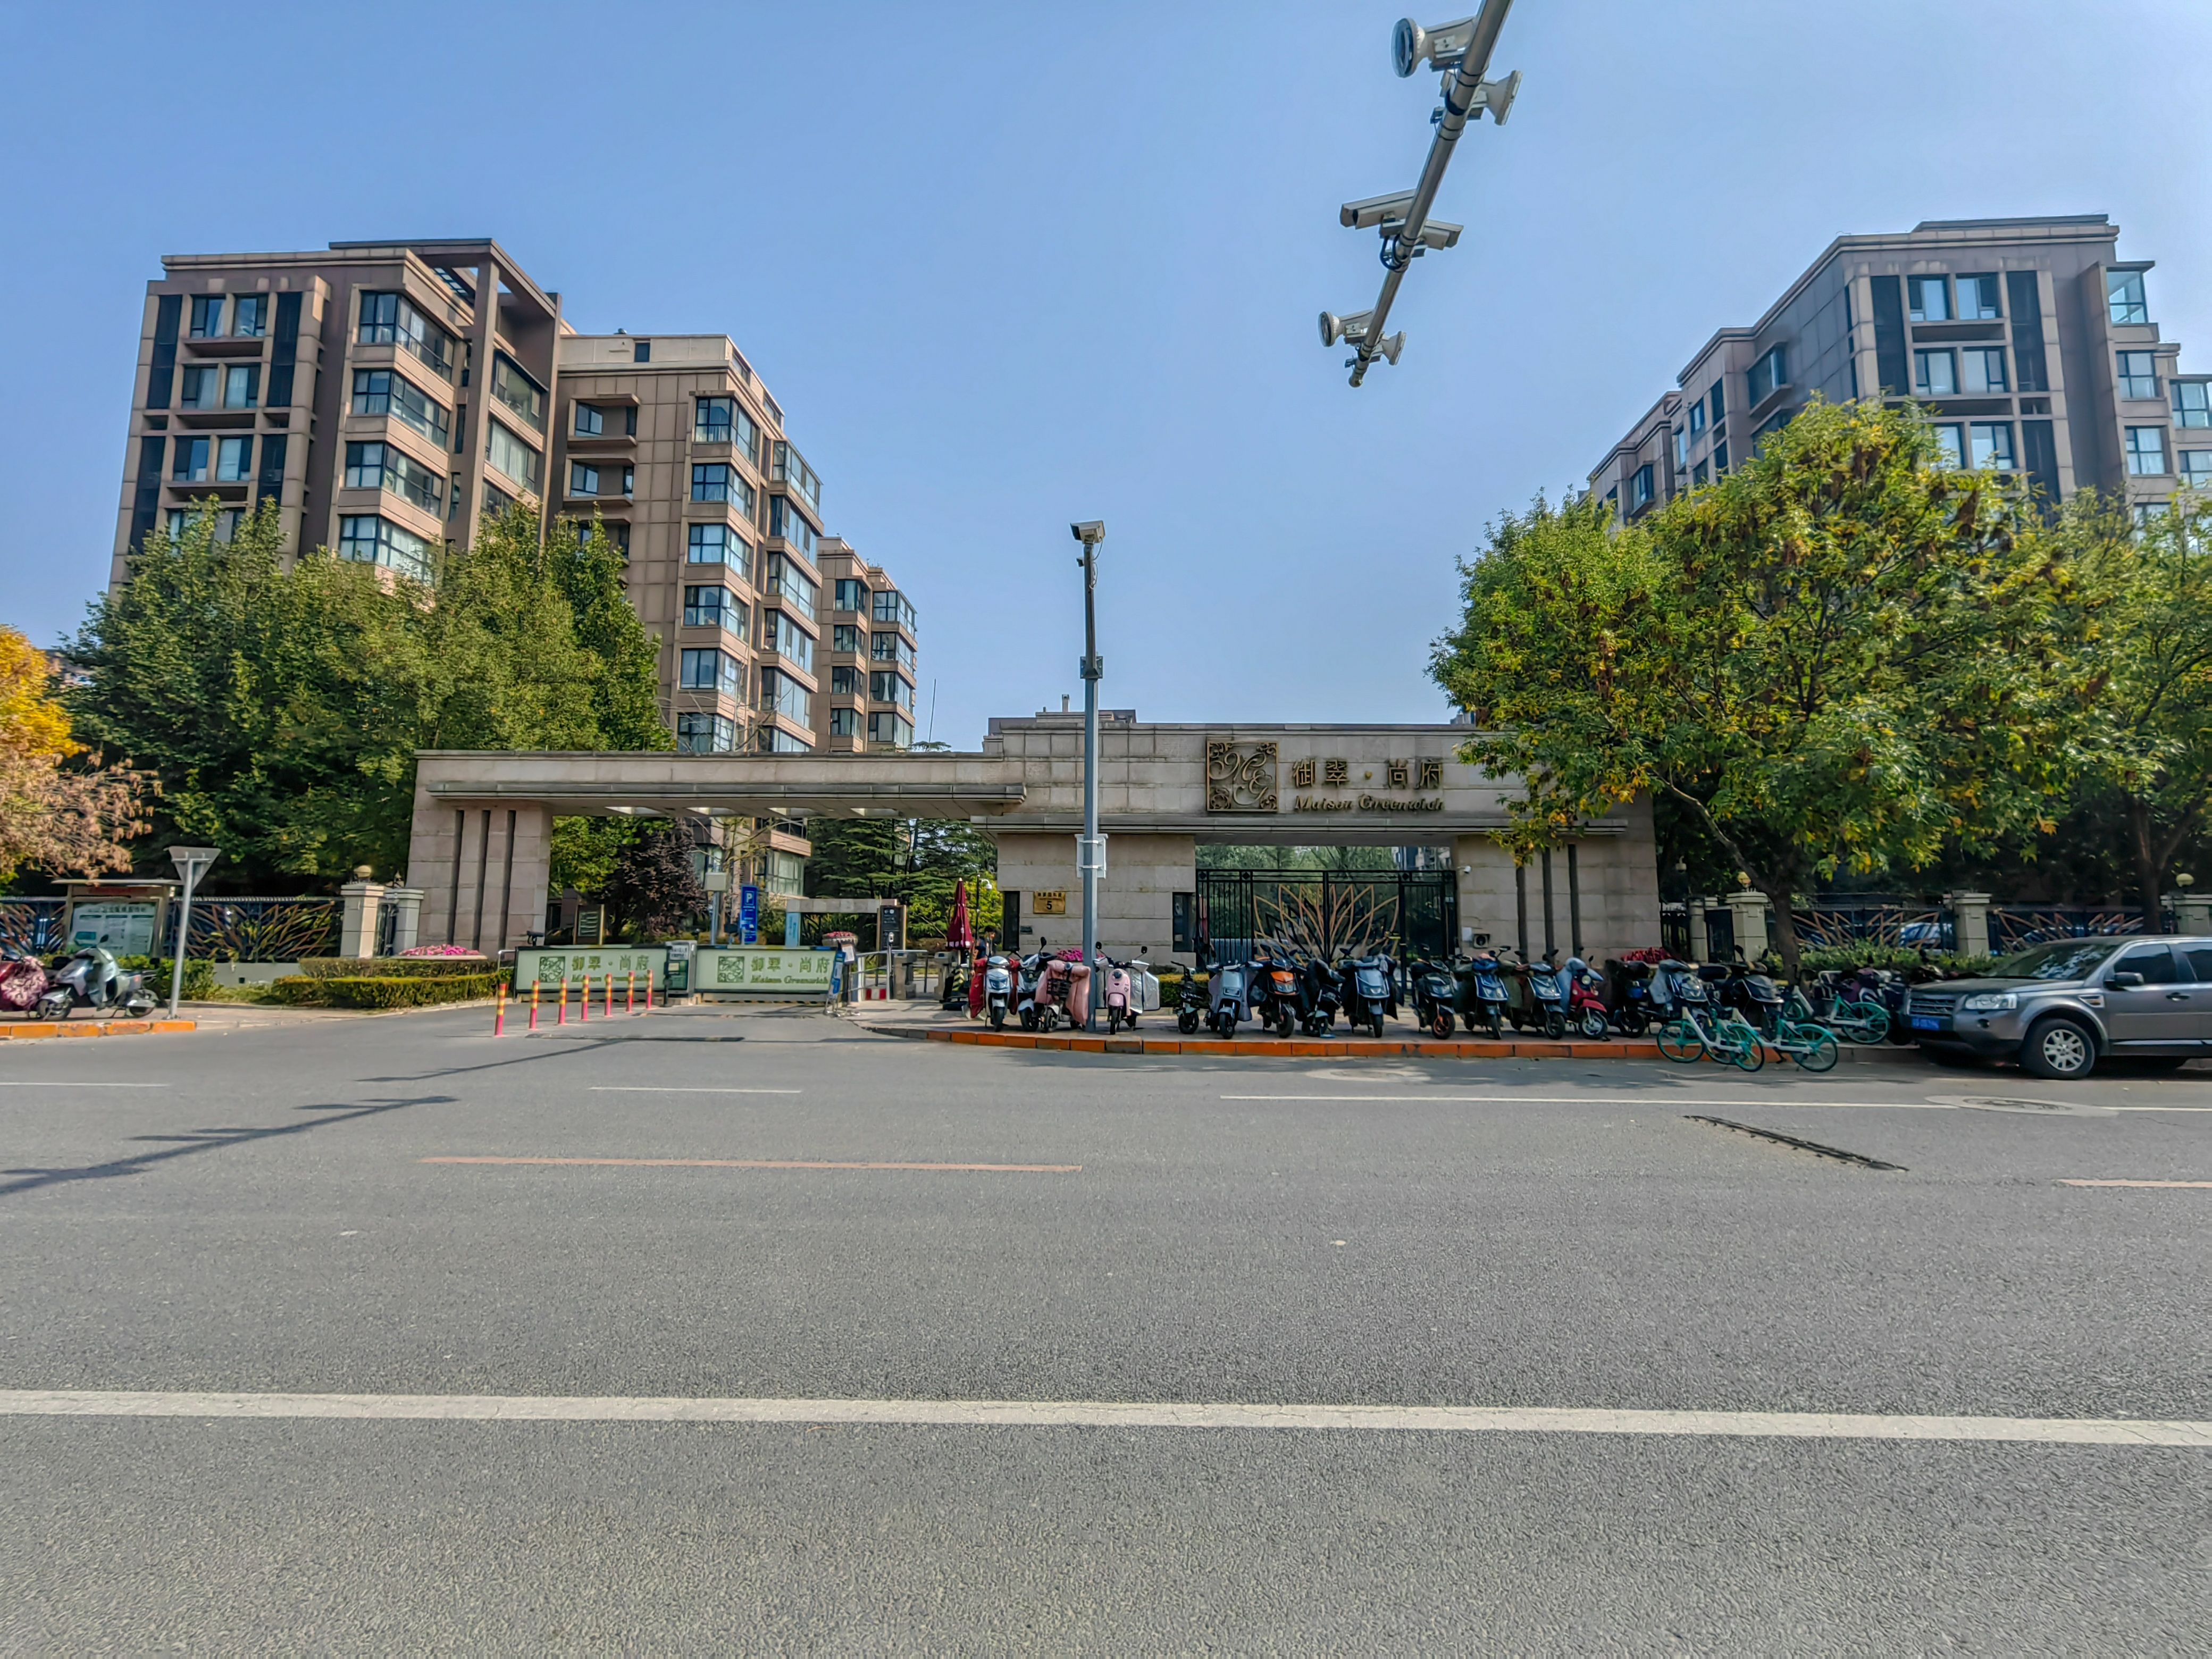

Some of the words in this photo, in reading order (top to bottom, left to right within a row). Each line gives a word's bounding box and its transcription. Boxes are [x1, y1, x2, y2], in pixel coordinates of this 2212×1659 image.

[1294, 795, 1352, 811] Maison
[1358, 794, 1445, 811] Greenwich
[746, 893, 752, 903] P
[1046, 901, 1052, 910] 5
